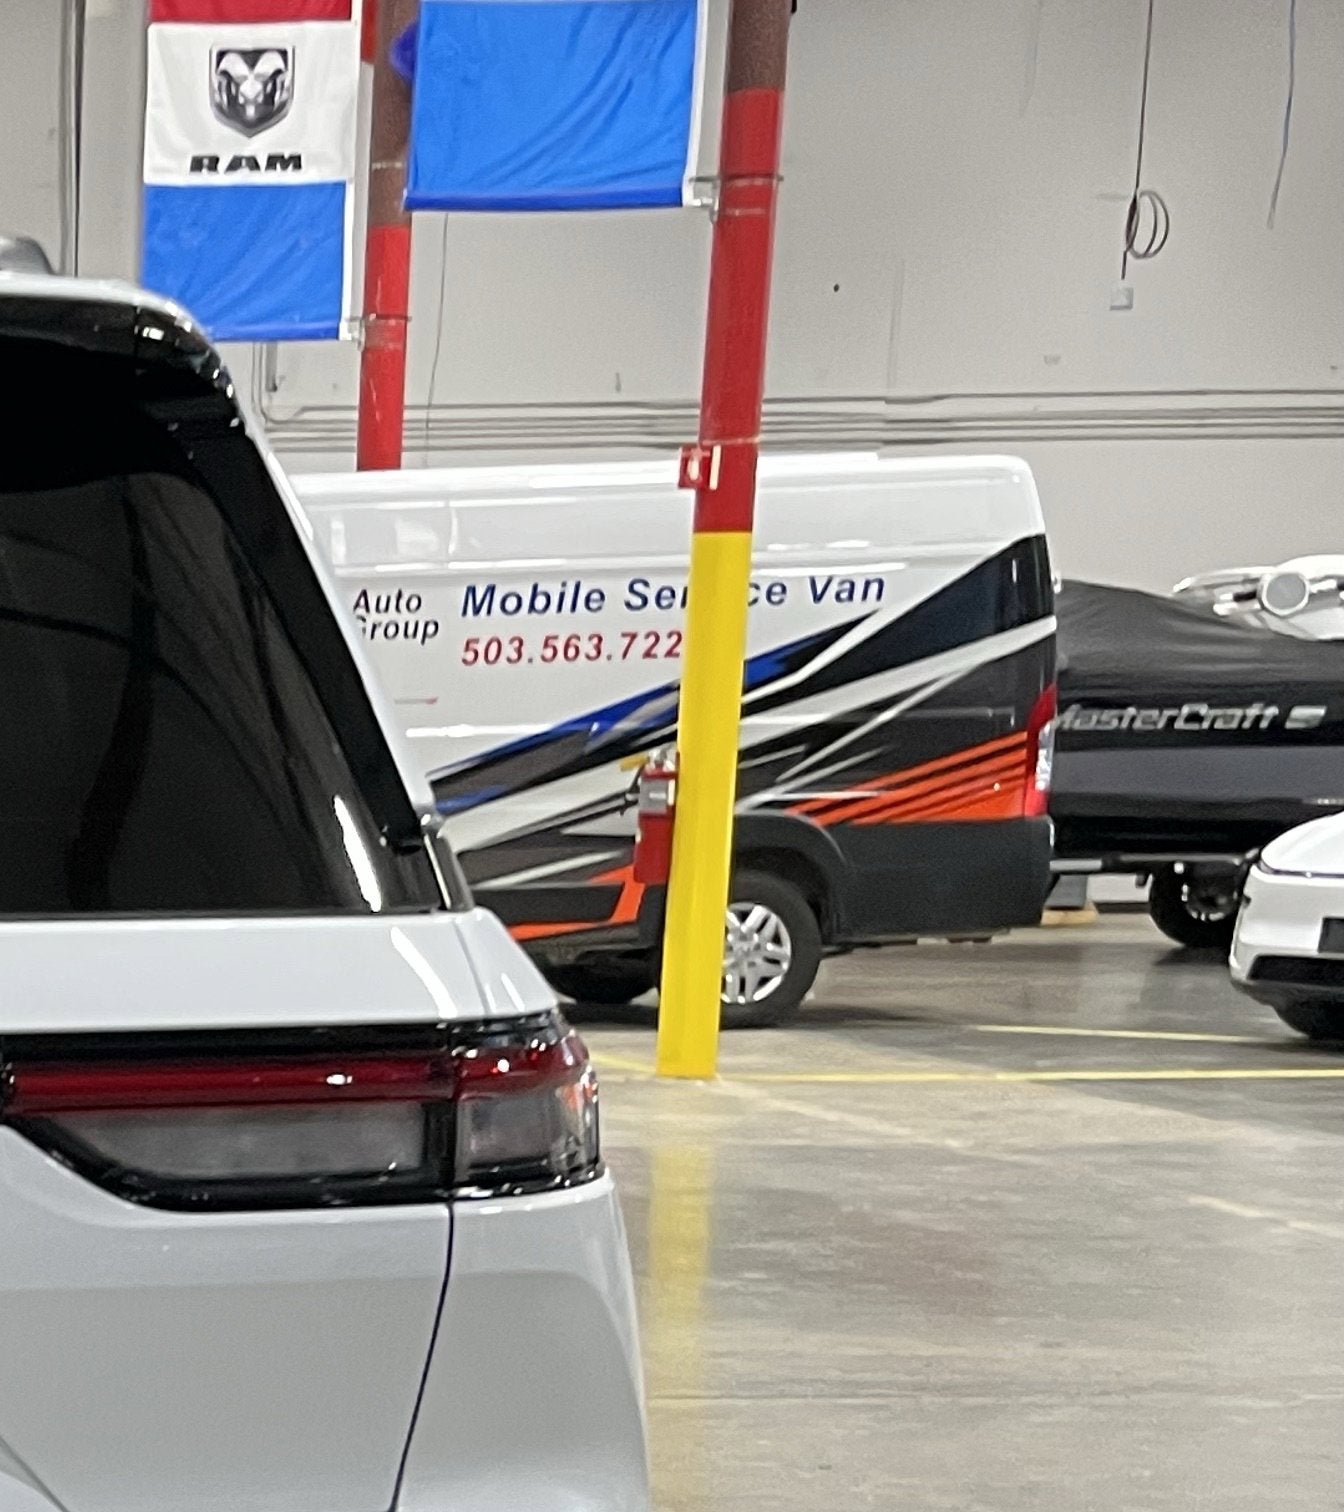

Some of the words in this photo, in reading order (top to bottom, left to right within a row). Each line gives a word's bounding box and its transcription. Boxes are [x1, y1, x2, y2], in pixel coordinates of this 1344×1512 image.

[189, 152, 303, 175] RAM
[353, 588, 422, 614] Auto
[461, 580, 606, 618] Mobile
[807, 575, 886, 605] Van
[461, 629, 683, 667] 503.563.722
